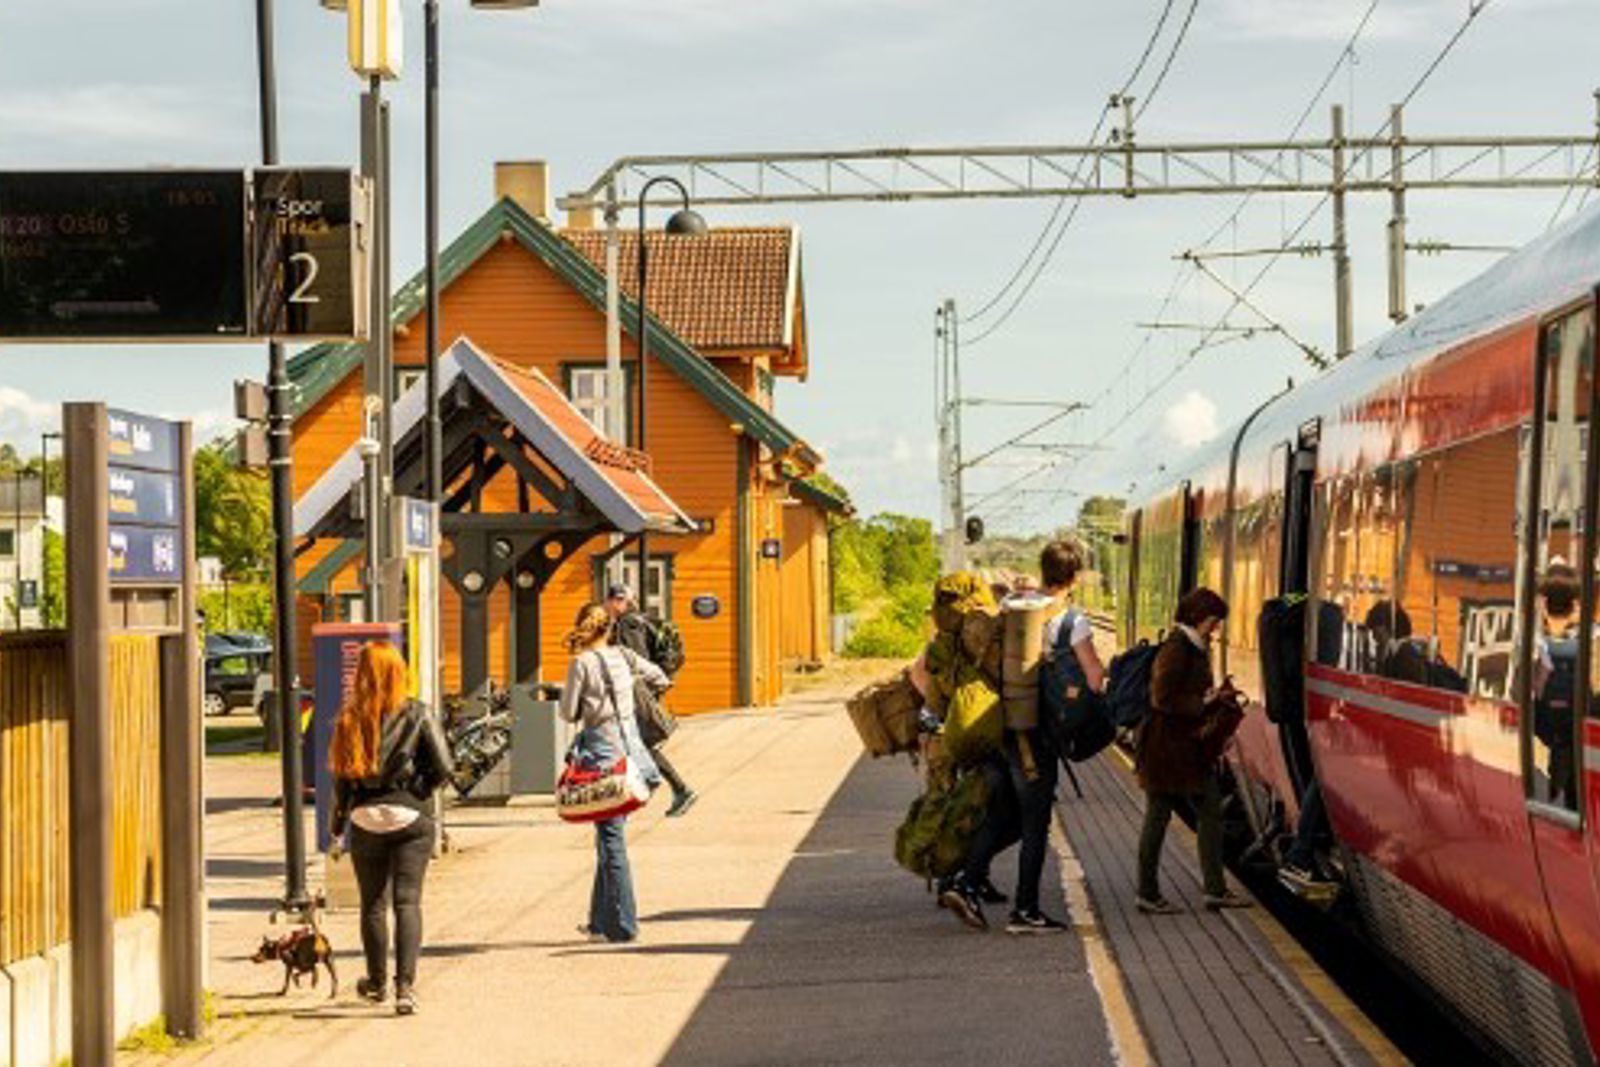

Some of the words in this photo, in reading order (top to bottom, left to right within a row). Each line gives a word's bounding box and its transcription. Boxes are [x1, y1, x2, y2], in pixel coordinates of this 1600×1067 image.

[277, 197, 322, 217] Spor
[58, 209, 109, 235] Oslo
[288, 251, 320, 303] 2
